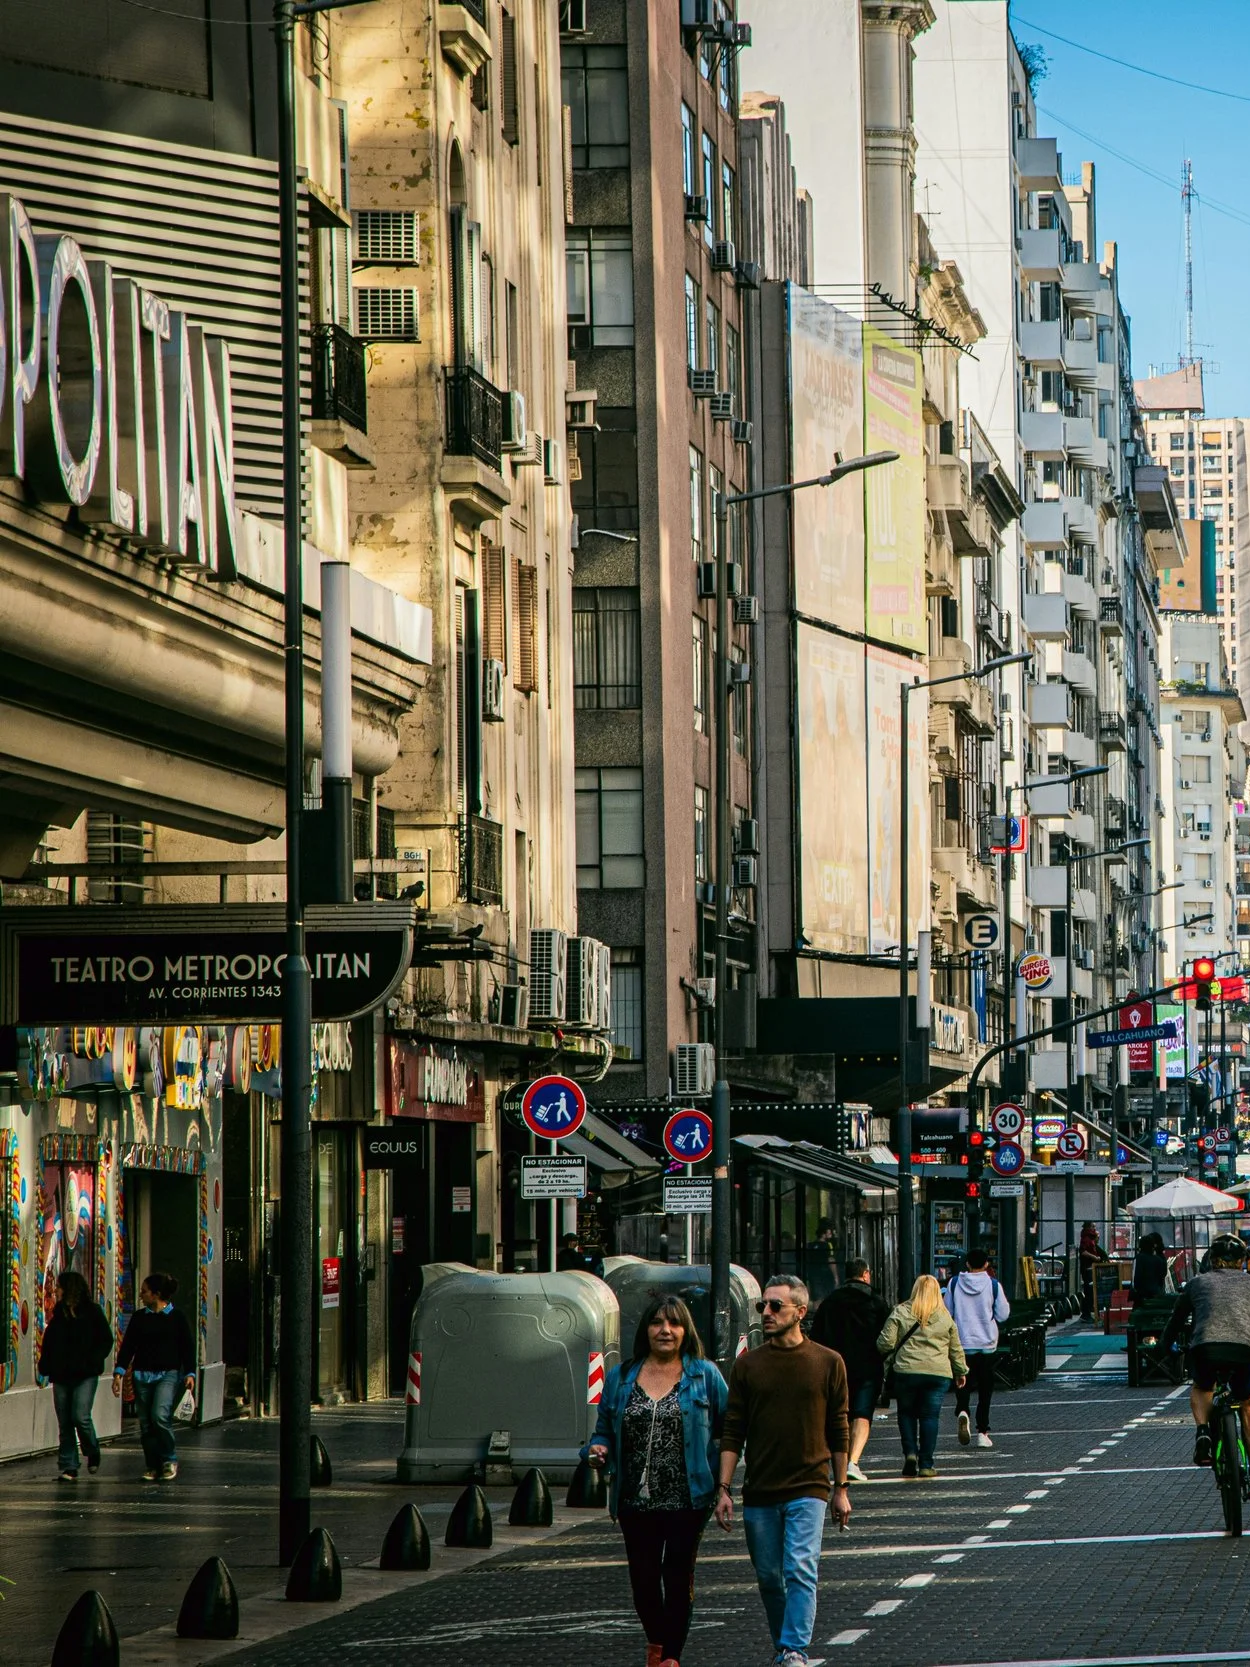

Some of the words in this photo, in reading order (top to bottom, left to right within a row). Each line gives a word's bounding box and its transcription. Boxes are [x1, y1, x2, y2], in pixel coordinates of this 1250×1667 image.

[0, 193, 237, 582] POLITAN
[972, 920, 991, 943] E
[51, 956, 154, 983] TEATRO
[164, 953, 370, 983] METROPITAN
[1020, 960, 1049, 974] BURGER
[1023, 966, 1050, 981] KING
[149, 988, 168, 999] AV.
[172, 986, 247, 999] CORRIENTES
[252, 985, 281, 998] 1343
[1100, 1027, 1165, 1044] TALCAHUANO
[504, 1102, 522, 1110] OUR
[999, 1113, 1018, 1129] 30
[370, 1142, 417, 1153] EQUUS
[1204, 1138, 1213, 1146] 30
